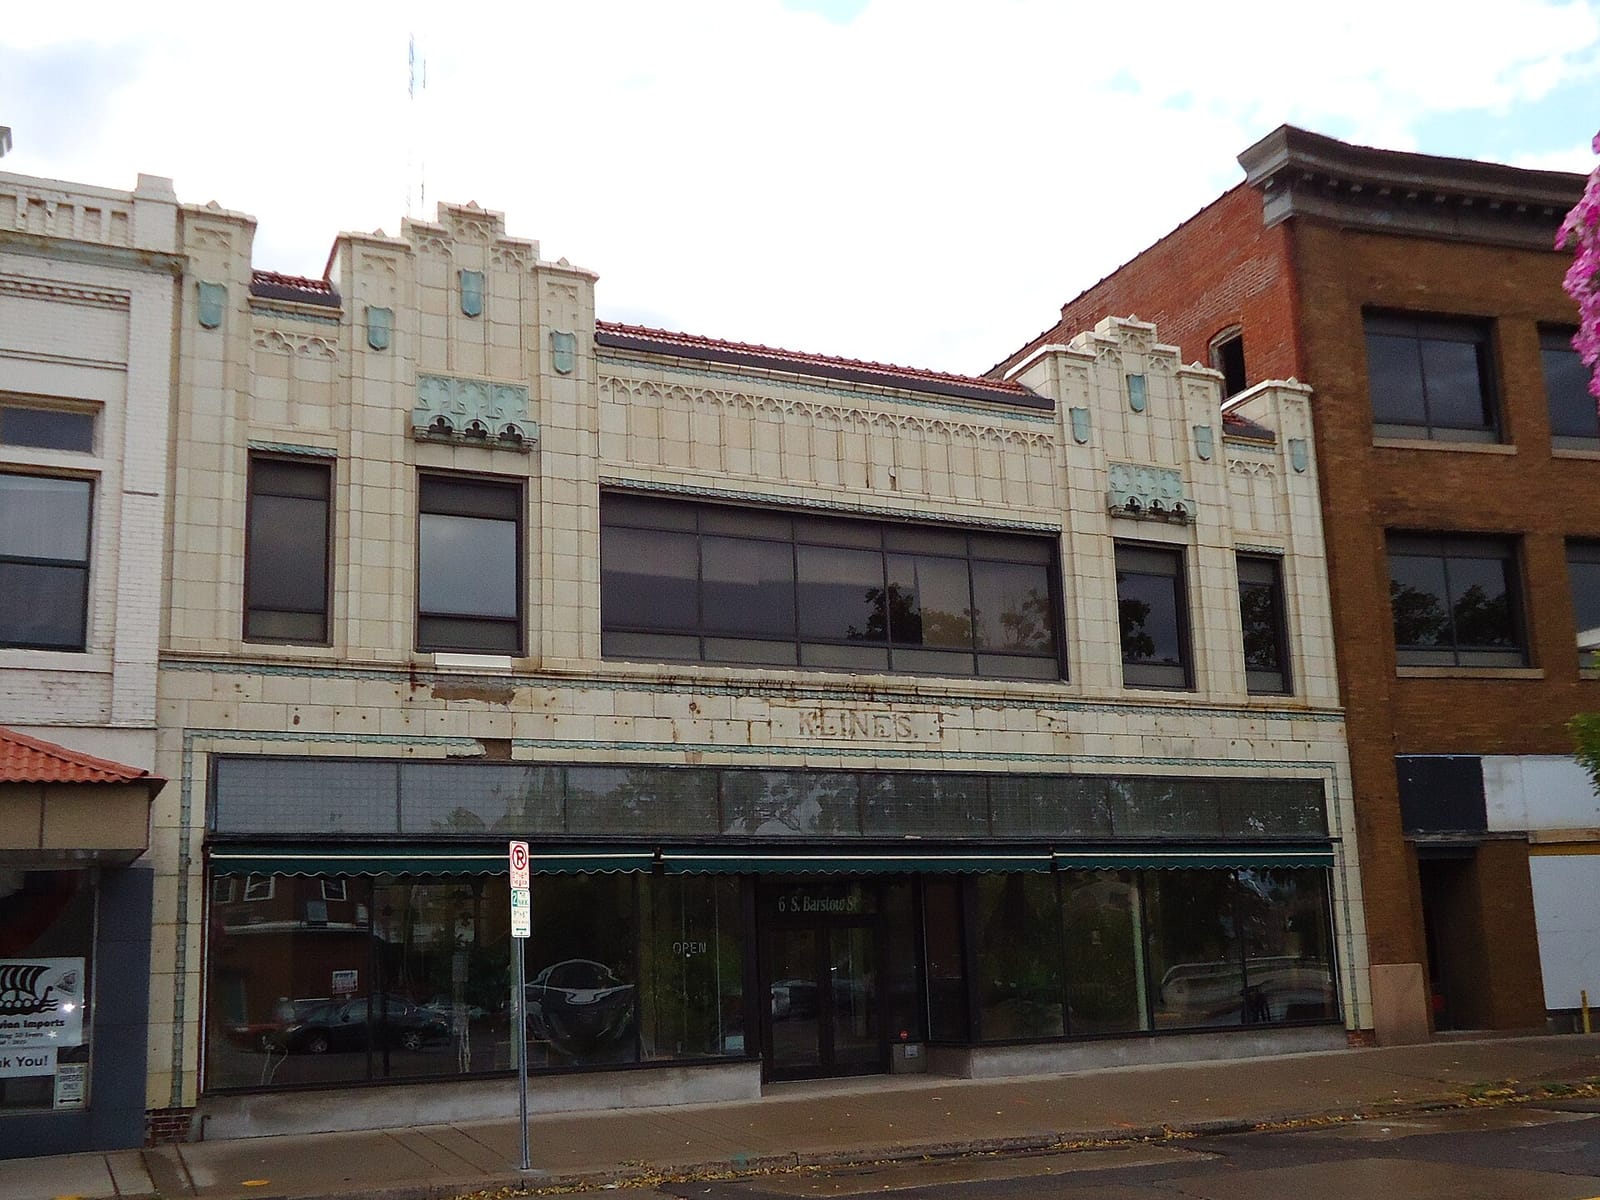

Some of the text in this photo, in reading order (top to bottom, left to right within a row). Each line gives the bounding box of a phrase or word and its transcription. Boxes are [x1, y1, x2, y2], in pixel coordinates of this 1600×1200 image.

[778, 895, 786, 912] 6
[803, 895, 845, 912] Barstow
[673, 942, 706, 954] OPEN
[23, 1018, 65, 1030] Imports
[15, 1054, 48, 1068] You!
